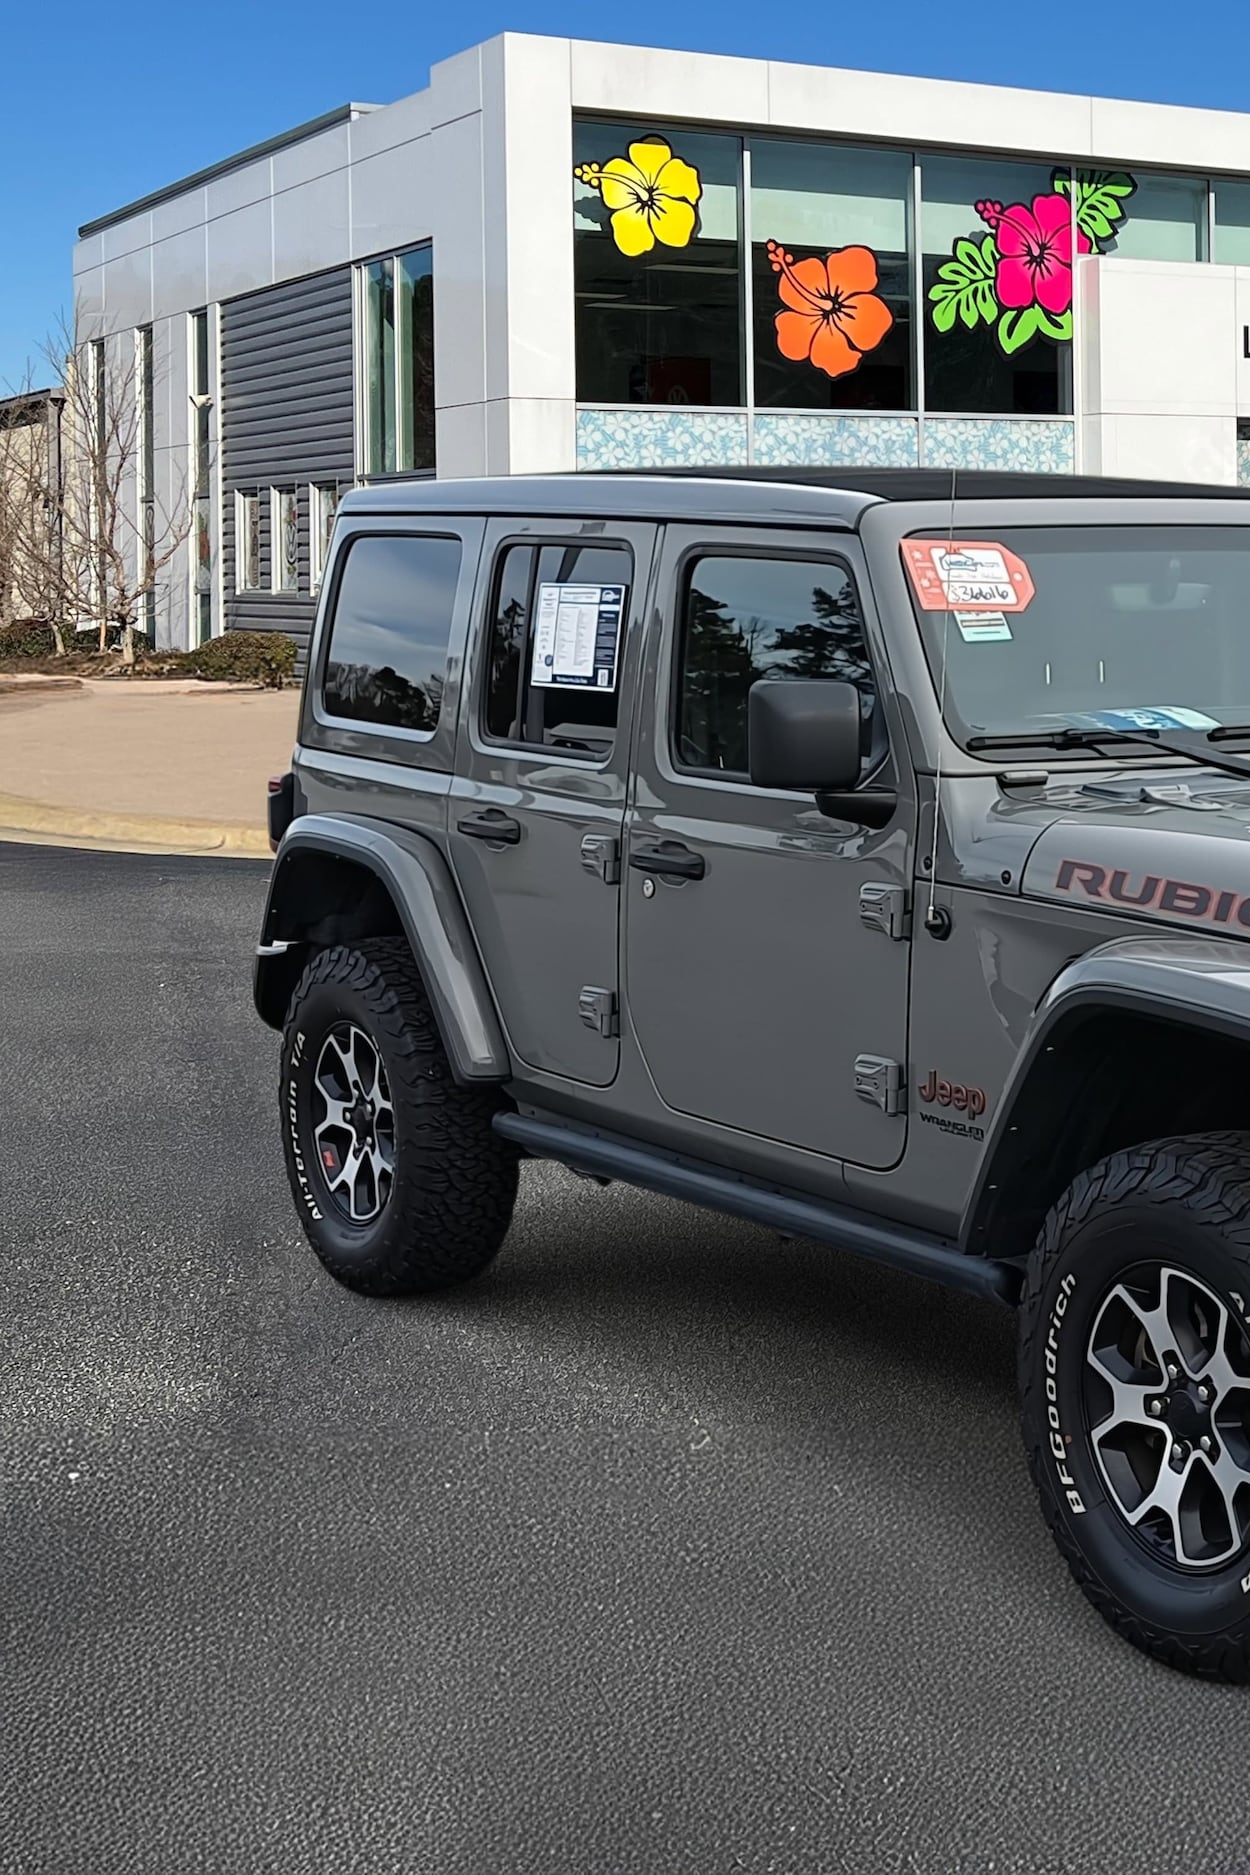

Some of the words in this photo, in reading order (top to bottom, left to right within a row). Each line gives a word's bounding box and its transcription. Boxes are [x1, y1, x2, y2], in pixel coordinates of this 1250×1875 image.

[290, 1030, 306, 1068] T/A
[918, 1069, 986, 1121] Jeep
[1044, 1271, 1087, 1516] BFGoodrich
